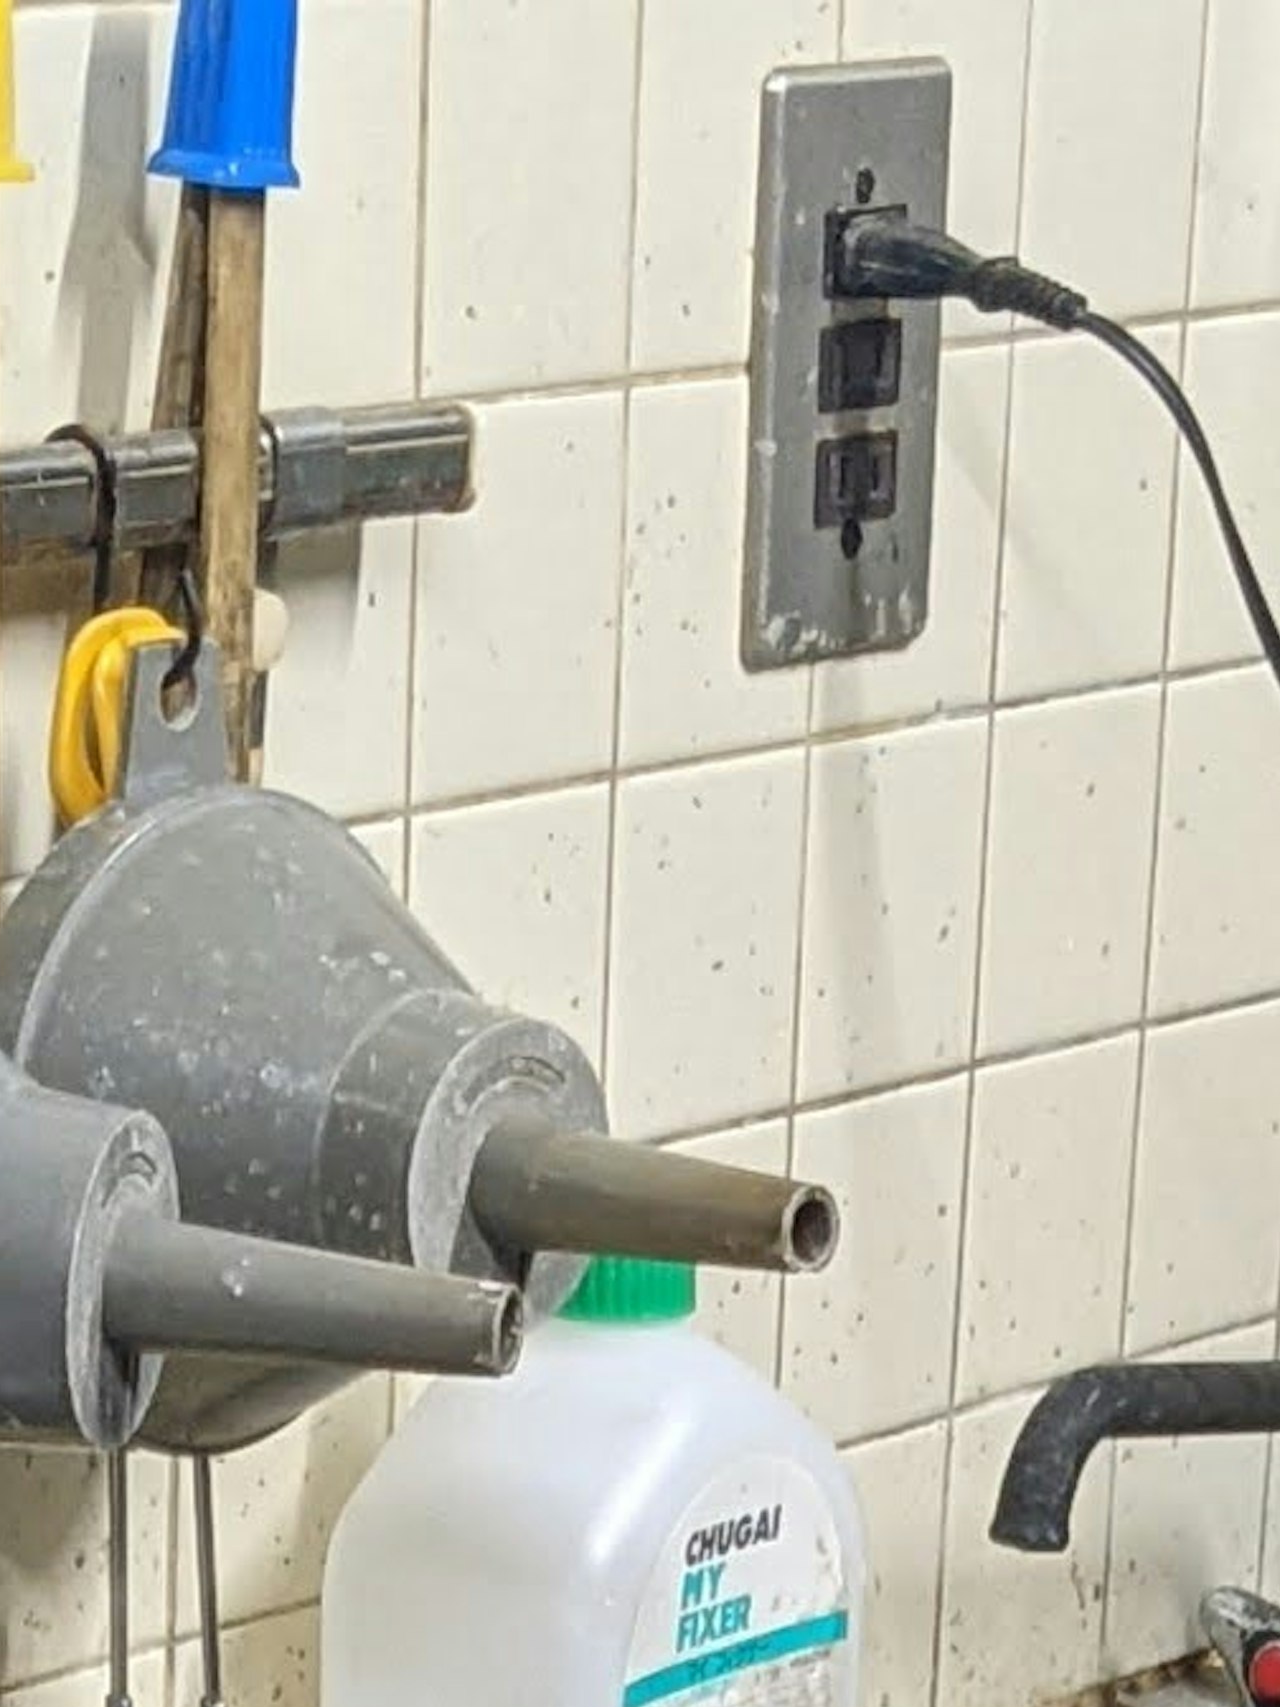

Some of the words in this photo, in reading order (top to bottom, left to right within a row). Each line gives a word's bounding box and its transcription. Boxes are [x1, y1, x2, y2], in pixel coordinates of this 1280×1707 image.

[685, 1503, 783, 1566] CHUGAI
[680, 1561, 727, 1611] MY
[676, 1595, 753, 1654] FIXER
